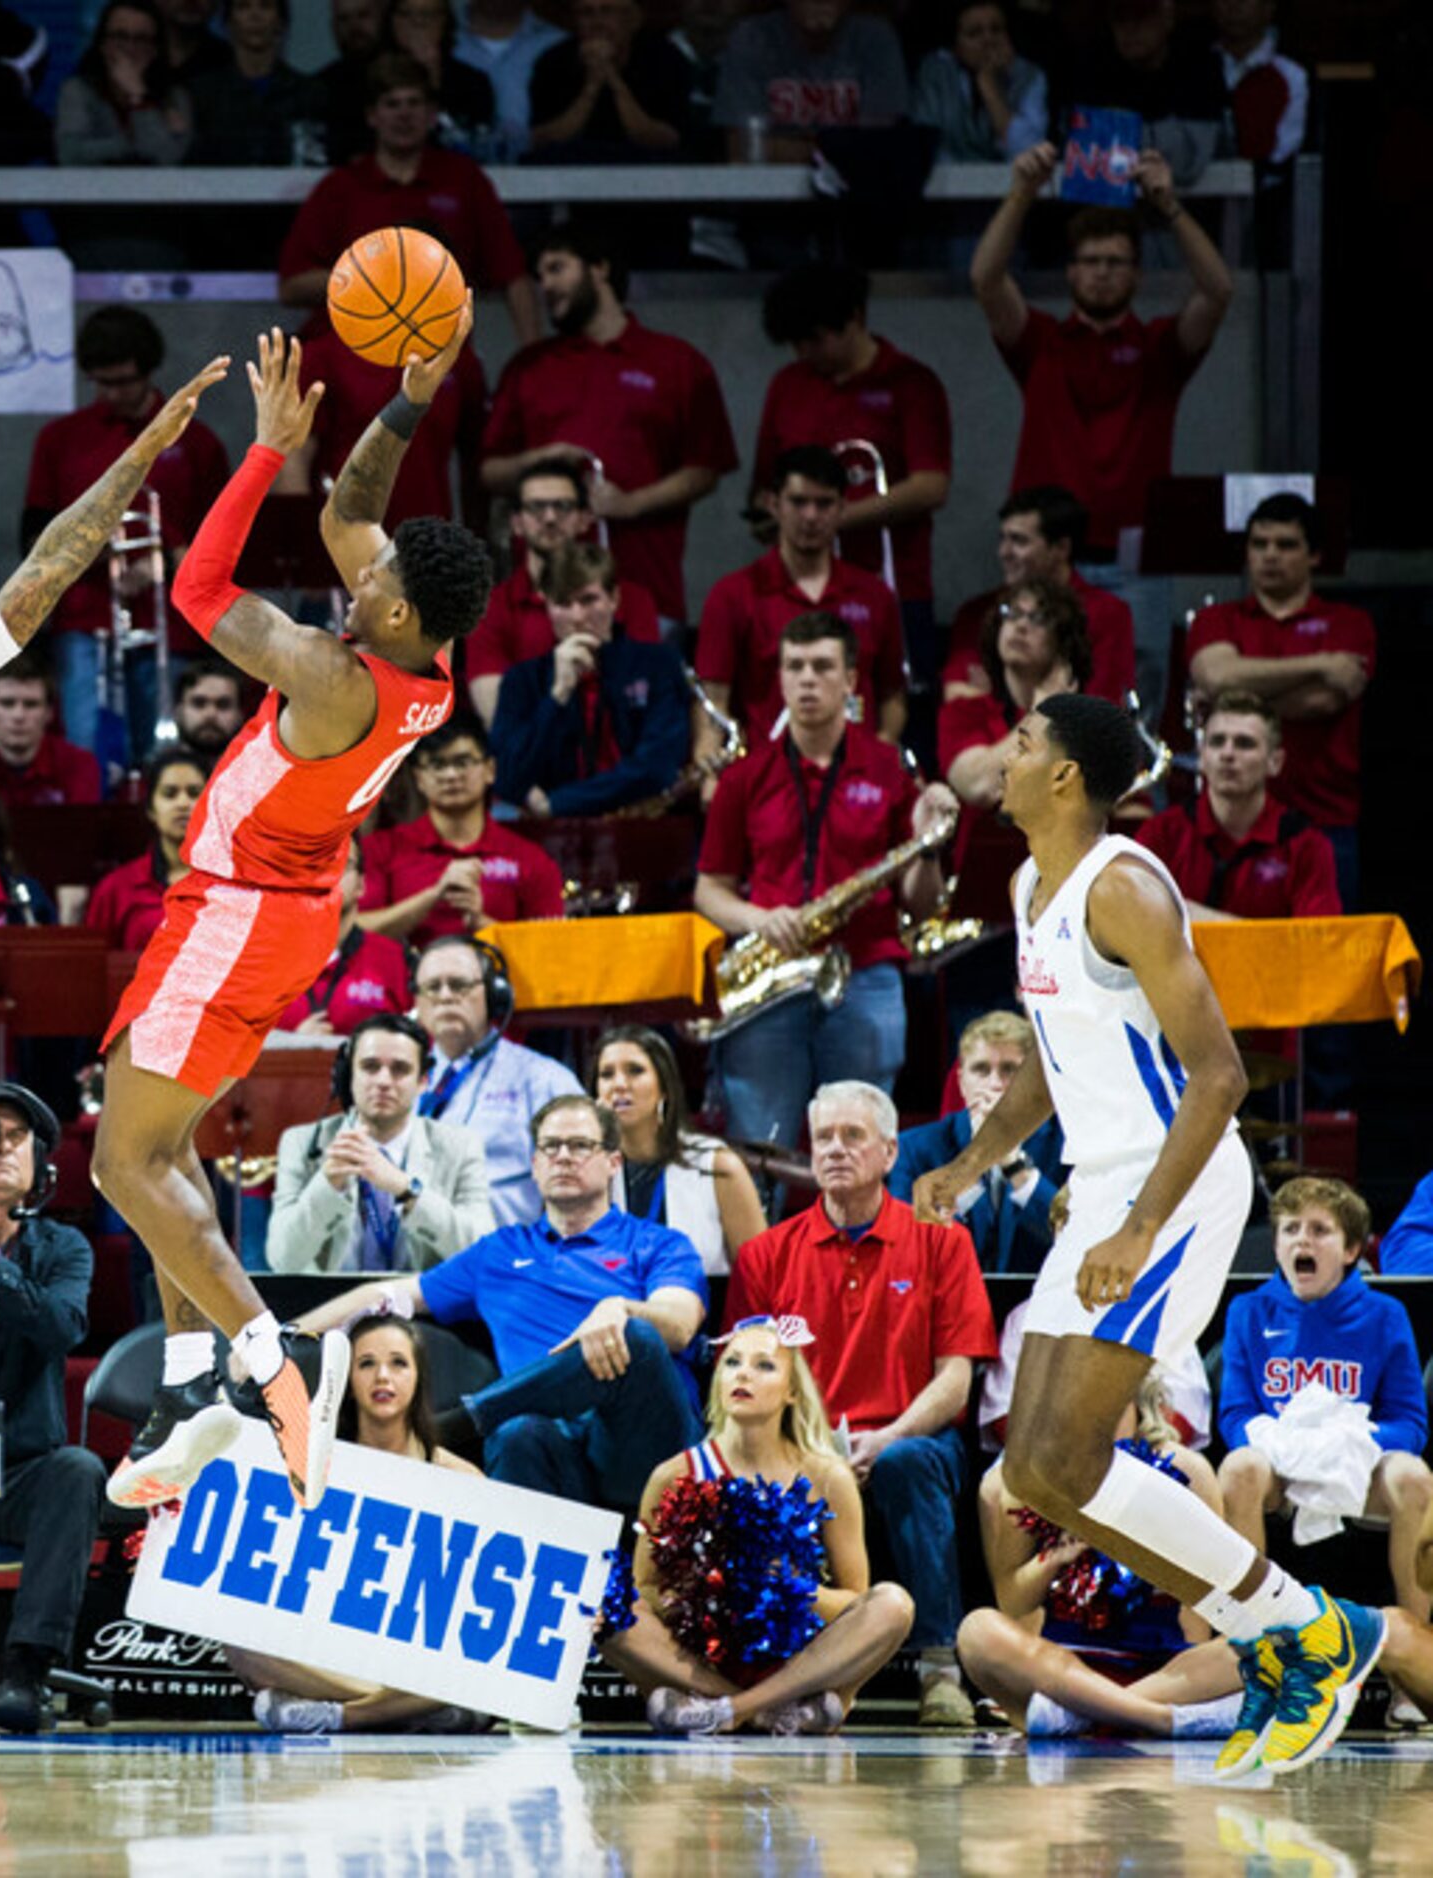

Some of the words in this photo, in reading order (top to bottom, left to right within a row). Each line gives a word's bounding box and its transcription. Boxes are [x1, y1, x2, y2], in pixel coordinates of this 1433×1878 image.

[769, 79, 859, 124] SMU
[1066, 139, 1138, 186] NO
[1035, 1008, 1063, 1075] 1
[1263, 1357, 1362, 1398] SMU
[161, 1458, 589, 1683] DEFENSE
[86, 1620, 179, 1662] Park
[91, 1677, 258, 1697] EALERSHIP
